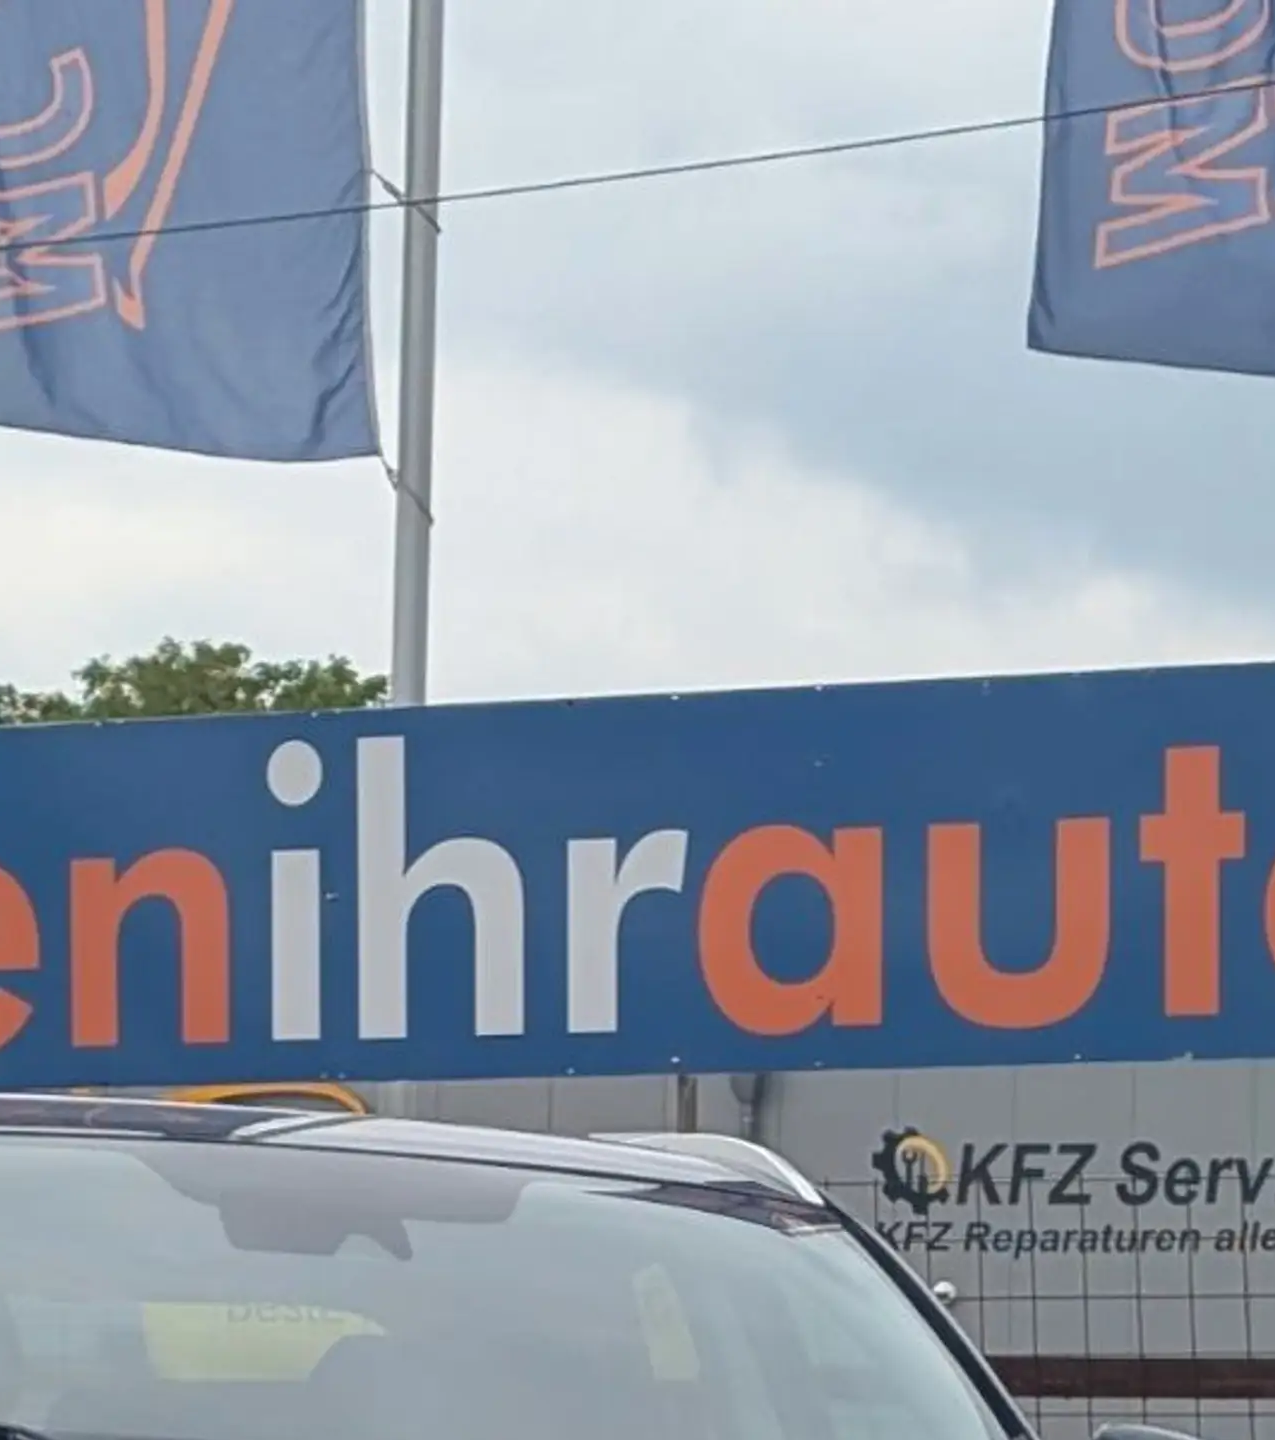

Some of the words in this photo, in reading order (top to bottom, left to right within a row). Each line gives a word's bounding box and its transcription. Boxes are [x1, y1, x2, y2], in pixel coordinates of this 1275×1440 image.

[956, 1143, 1097, 1205] KFZ
[875, 1221, 954, 1252] KFZ
[963, 1221, 1201, 1259] Reparaturen
